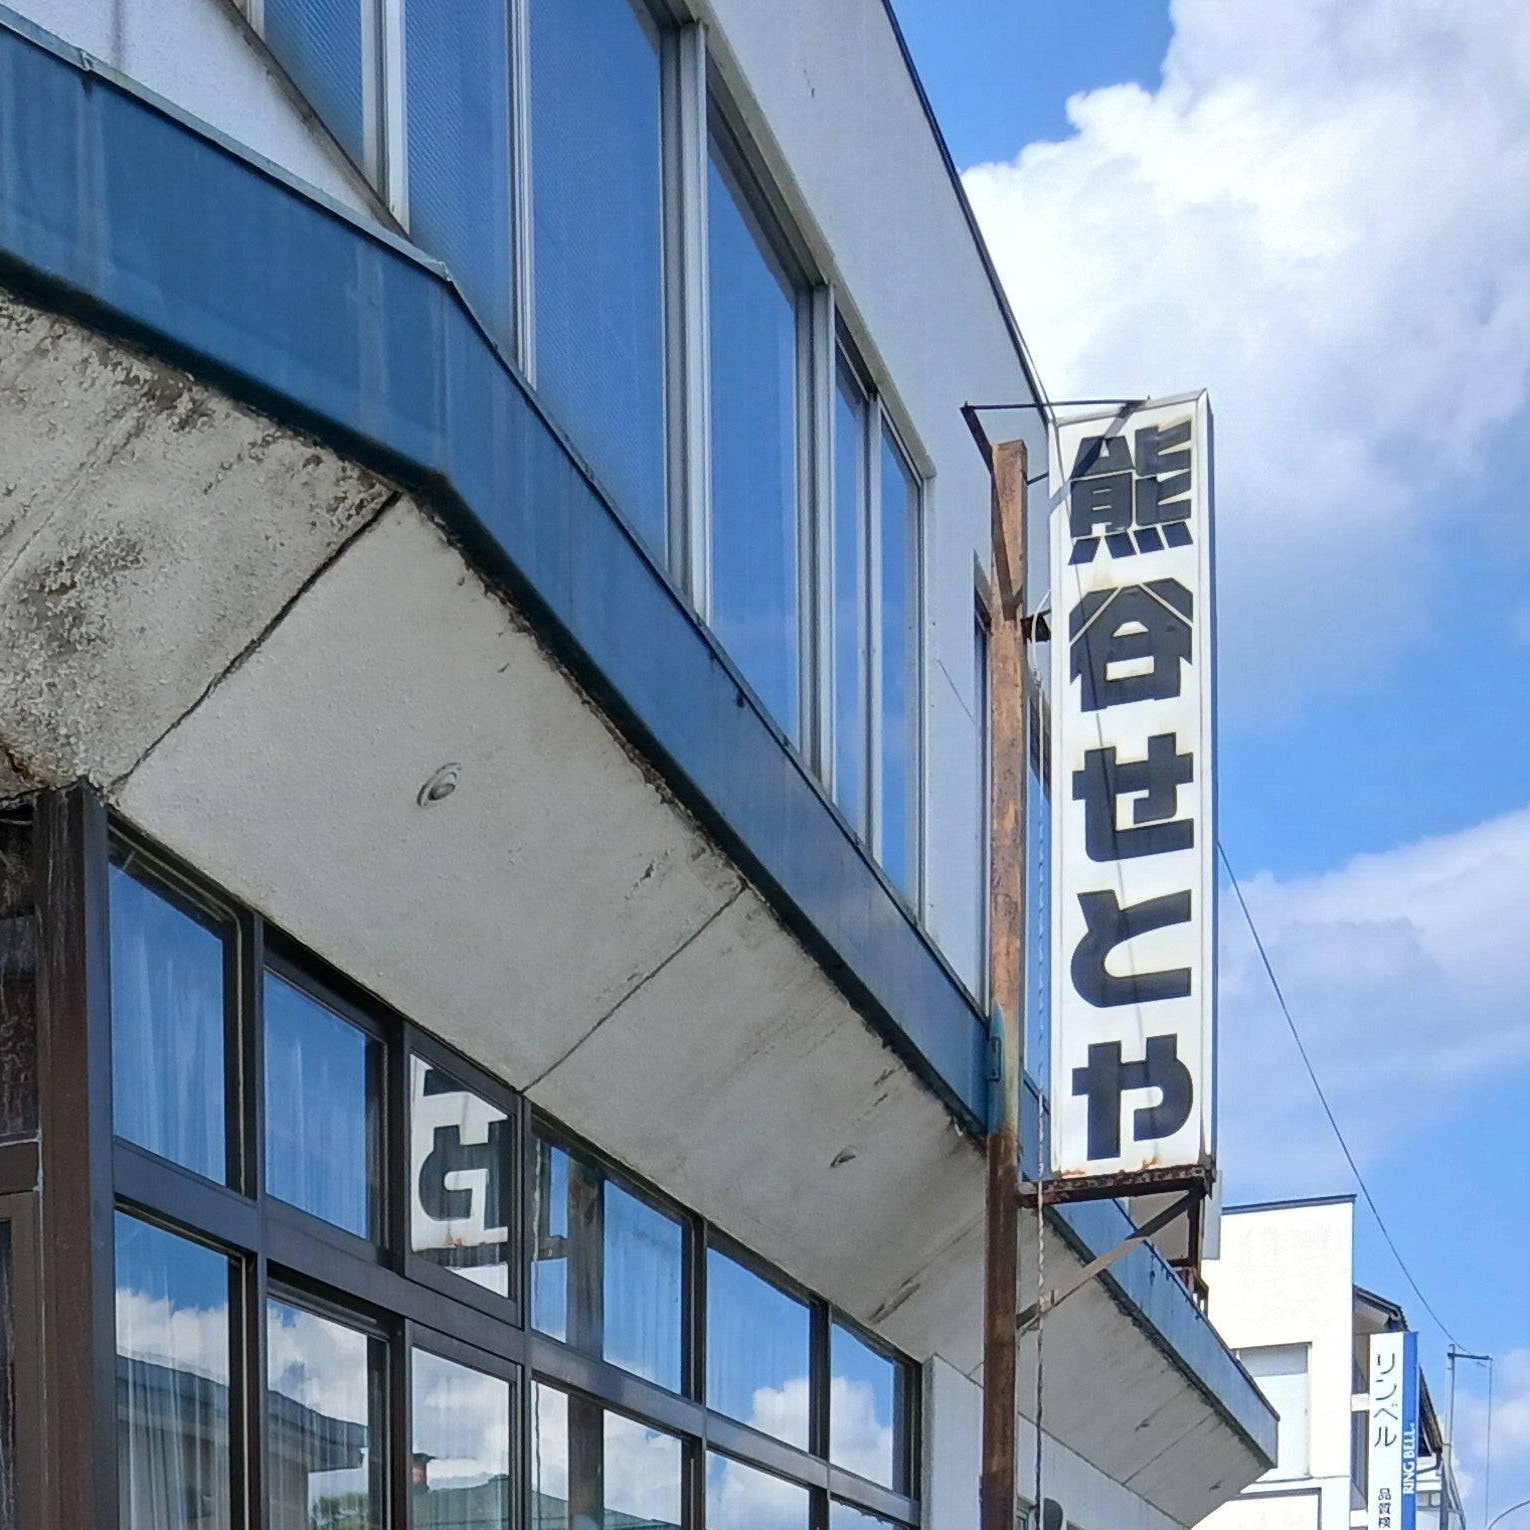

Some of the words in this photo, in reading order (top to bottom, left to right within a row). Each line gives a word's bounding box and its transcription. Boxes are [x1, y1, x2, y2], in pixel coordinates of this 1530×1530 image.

[1067, 417, 1195, 1162] 熊谷せとや
[1373, 1353, 1398, 1447] リンベル
[1402, 1461, 1415, 1495] RING
